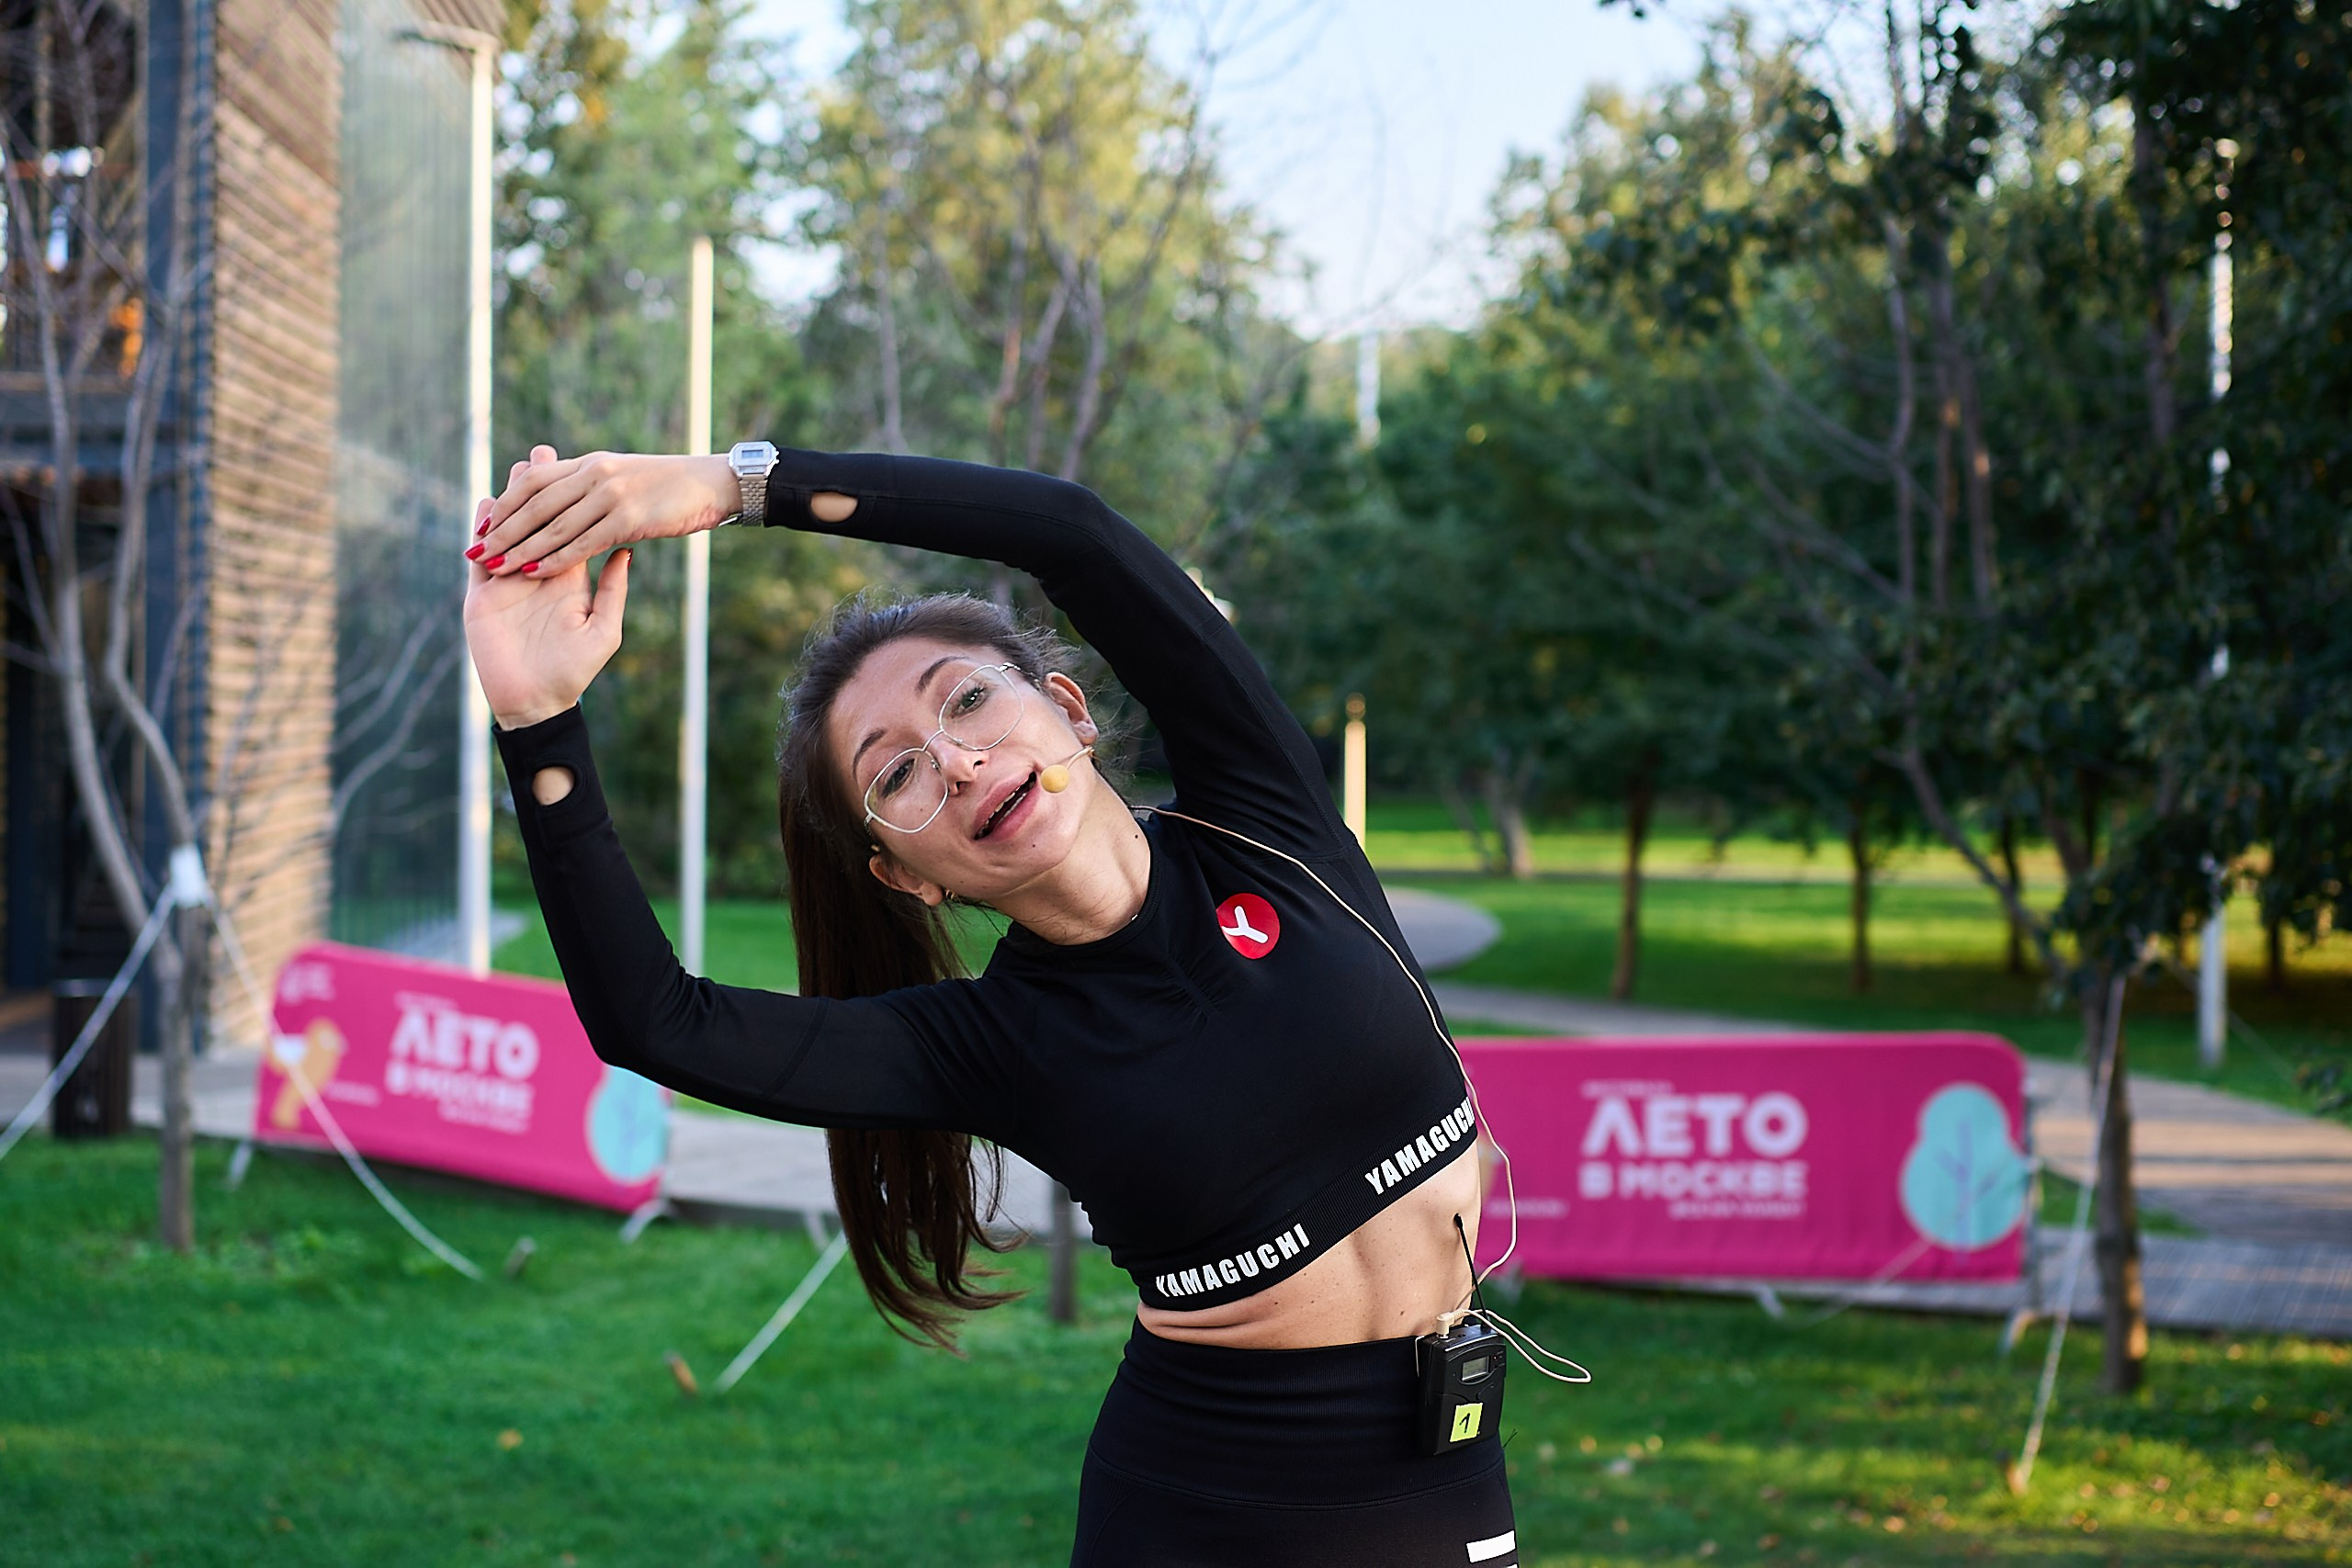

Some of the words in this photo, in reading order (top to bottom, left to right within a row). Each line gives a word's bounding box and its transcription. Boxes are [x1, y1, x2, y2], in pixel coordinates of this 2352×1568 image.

[1579, 1090, 1809, 1158] ЛЕТО
[1156, 1223, 1310, 1298] YAMAGUCHI
[1459, 1413, 1471, 1434] 1
